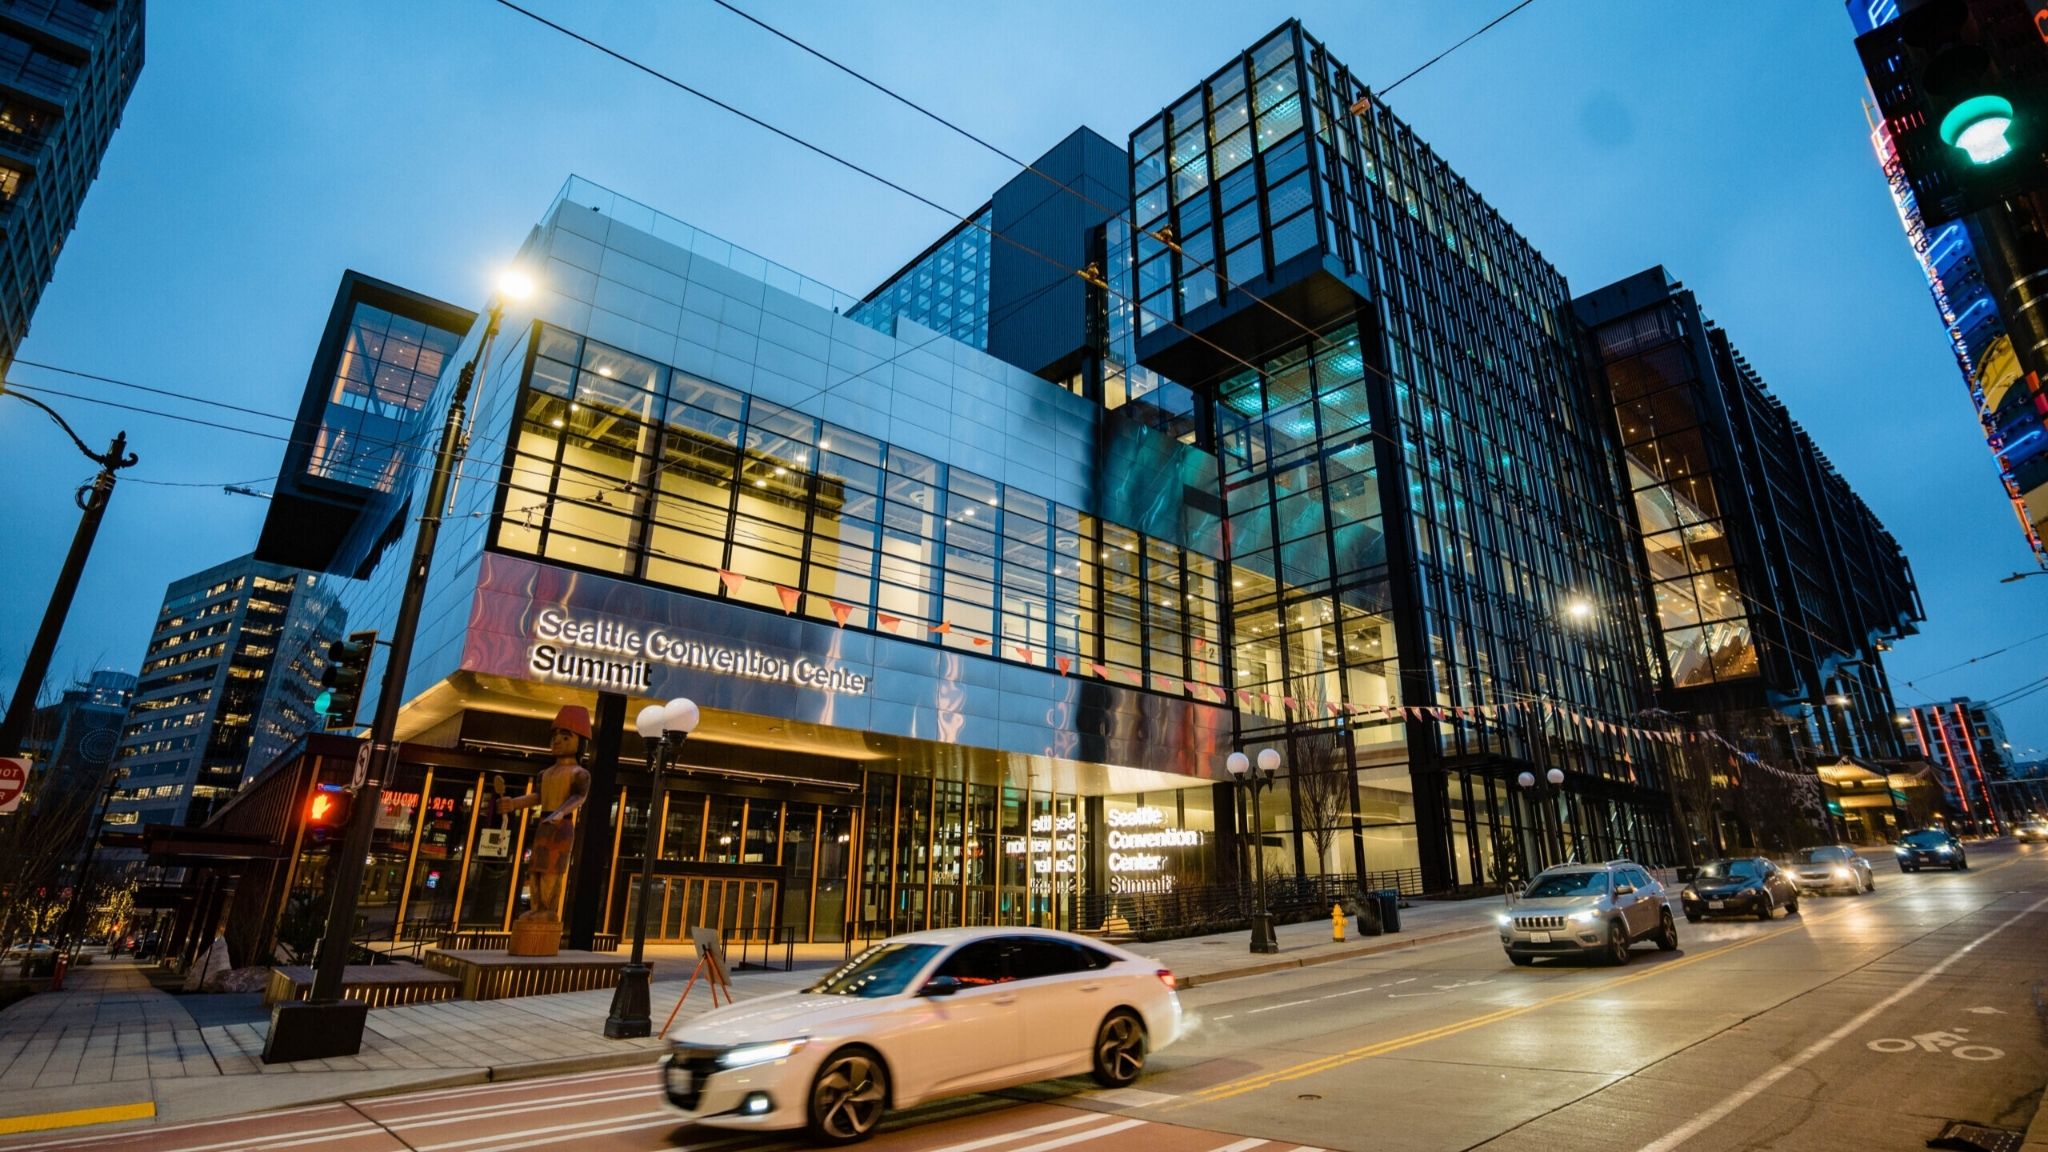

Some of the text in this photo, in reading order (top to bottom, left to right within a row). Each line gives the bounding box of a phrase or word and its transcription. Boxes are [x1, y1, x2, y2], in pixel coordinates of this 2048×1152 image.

[538, 608, 873, 694] Seattle Convention Center
[531, 644, 652, 691] Summit
[1390, 695, 1396, 704] 2
[1108, 807, 1164, 827] Seattle
[1108, 828, 1199, 849] Convention
[1108, 852, 1164, 871] Center
[1109, 875, 1173, 894] Summit
